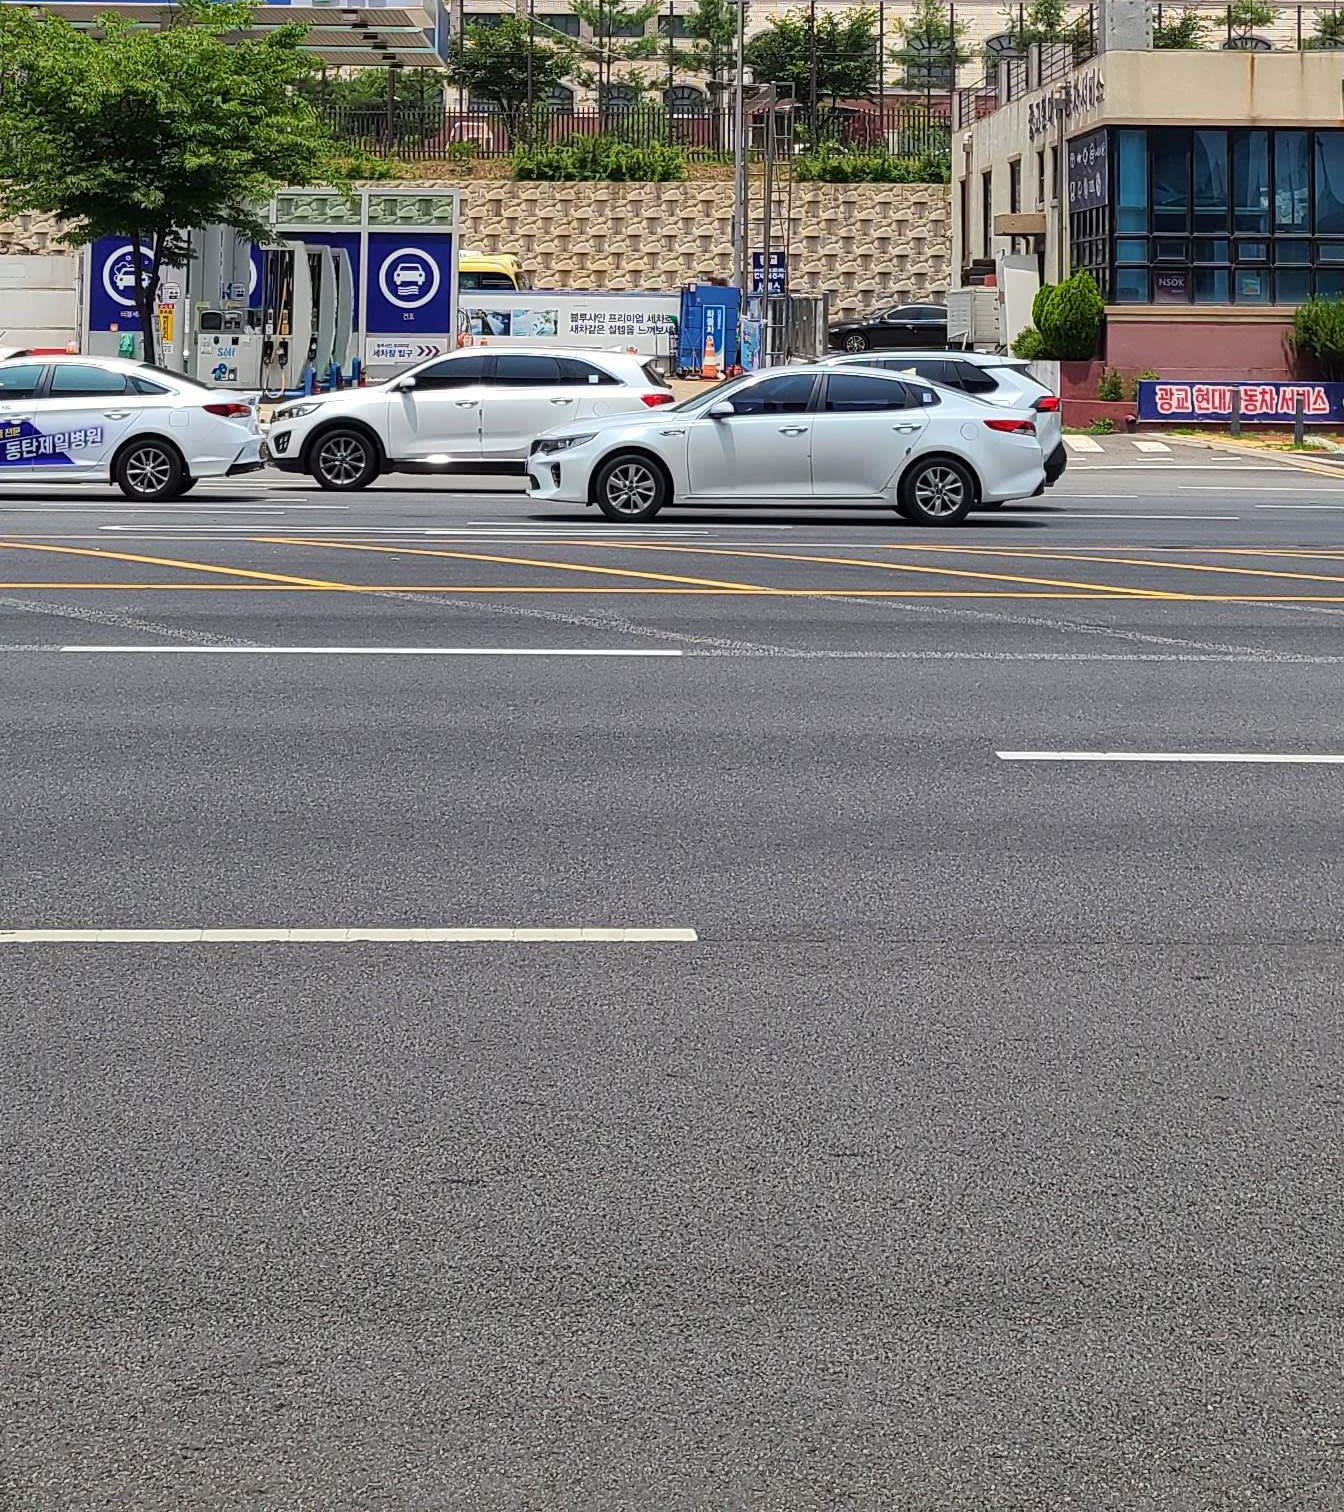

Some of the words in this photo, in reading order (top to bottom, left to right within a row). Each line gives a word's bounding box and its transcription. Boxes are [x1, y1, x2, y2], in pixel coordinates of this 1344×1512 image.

[1158, 278, 1185, 287] NSOK
[608, 313, 644, 324] 프리미엄
[1157, 387, 1192, 413] 광교
[6, 427, 103, 461] 동탄제일병원
